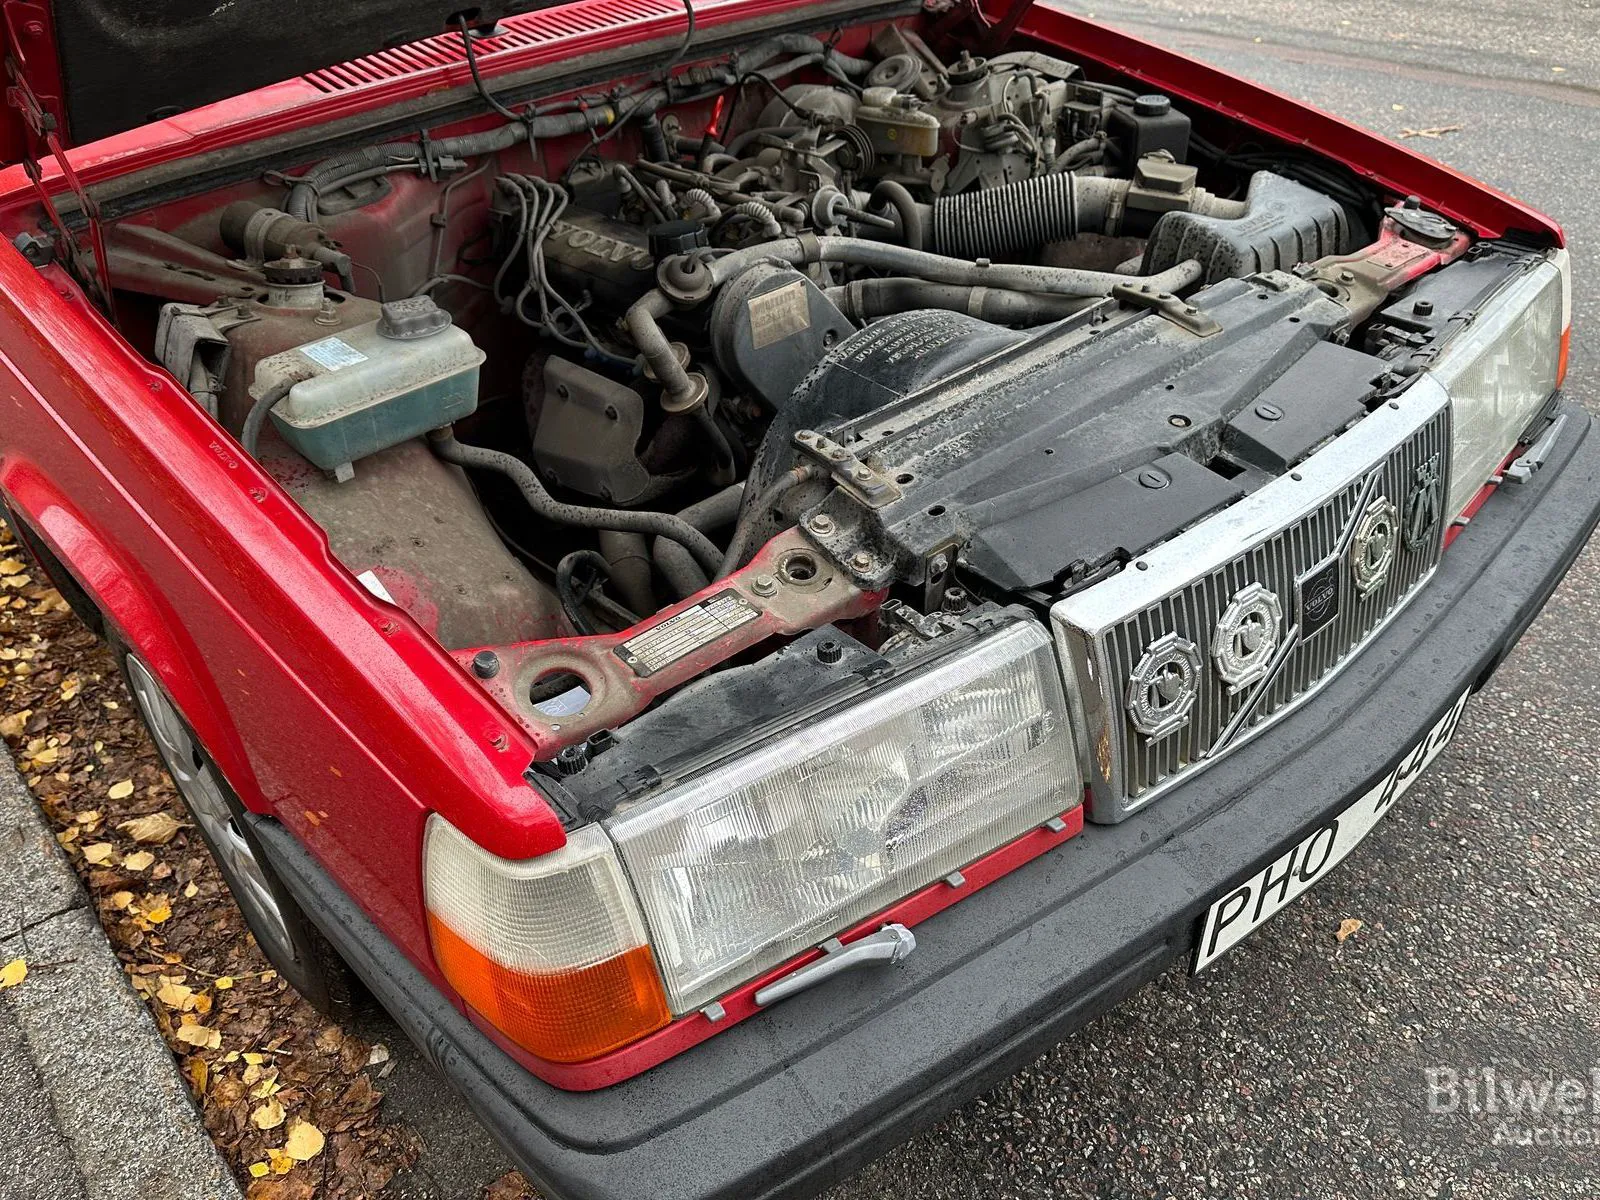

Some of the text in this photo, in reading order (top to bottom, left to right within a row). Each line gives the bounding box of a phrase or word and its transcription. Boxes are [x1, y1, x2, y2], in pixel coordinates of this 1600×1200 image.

[548, 220, 655, 271] VOLVO
[1304, 587, 1335, 612] VOLVO
[655, 616, 681, 631] VOLVO
[1206, 704, 1459, 958] PHO 444
